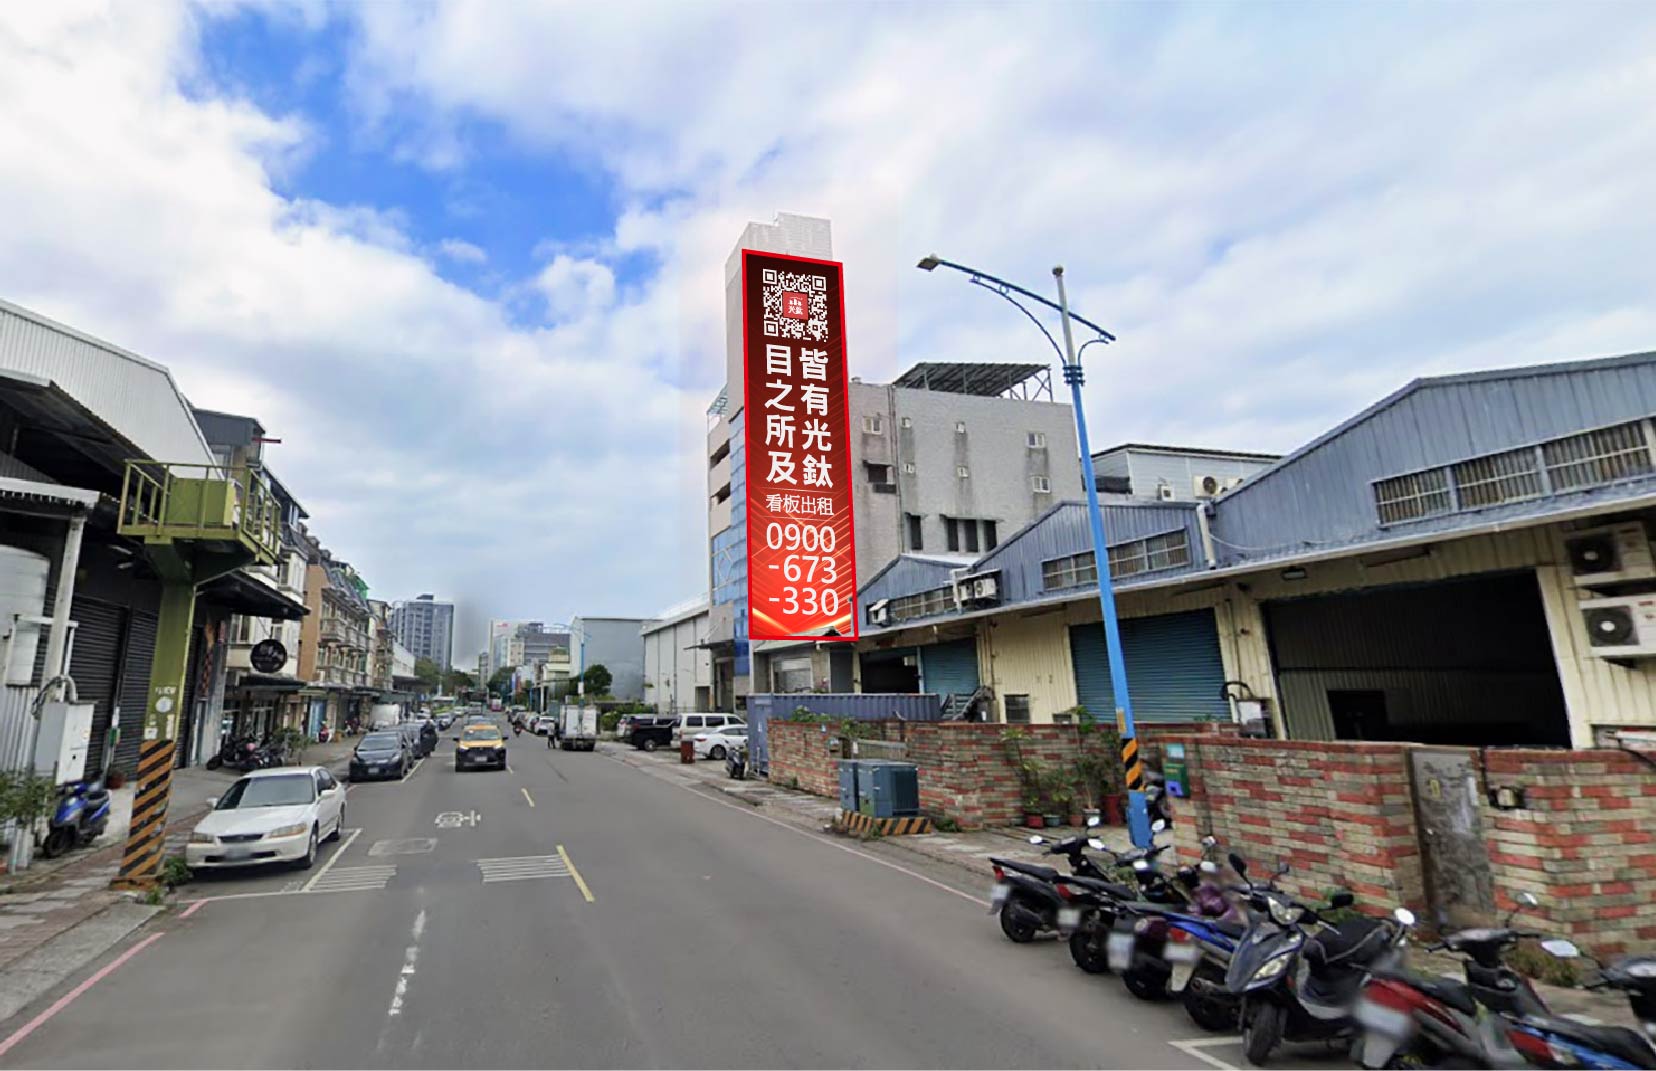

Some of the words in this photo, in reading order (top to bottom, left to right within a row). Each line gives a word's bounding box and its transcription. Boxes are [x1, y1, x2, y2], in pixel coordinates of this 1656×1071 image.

[765, 344, 797, 485] 目之所及
[799, 348, 834, 488] 皆有光鈦
[766, 493, 834, 515] 看板出租
[766, 522, 836, 553] 0900
[768, 554, 837, 584] -673
[768, 586, 839, 616] -330
